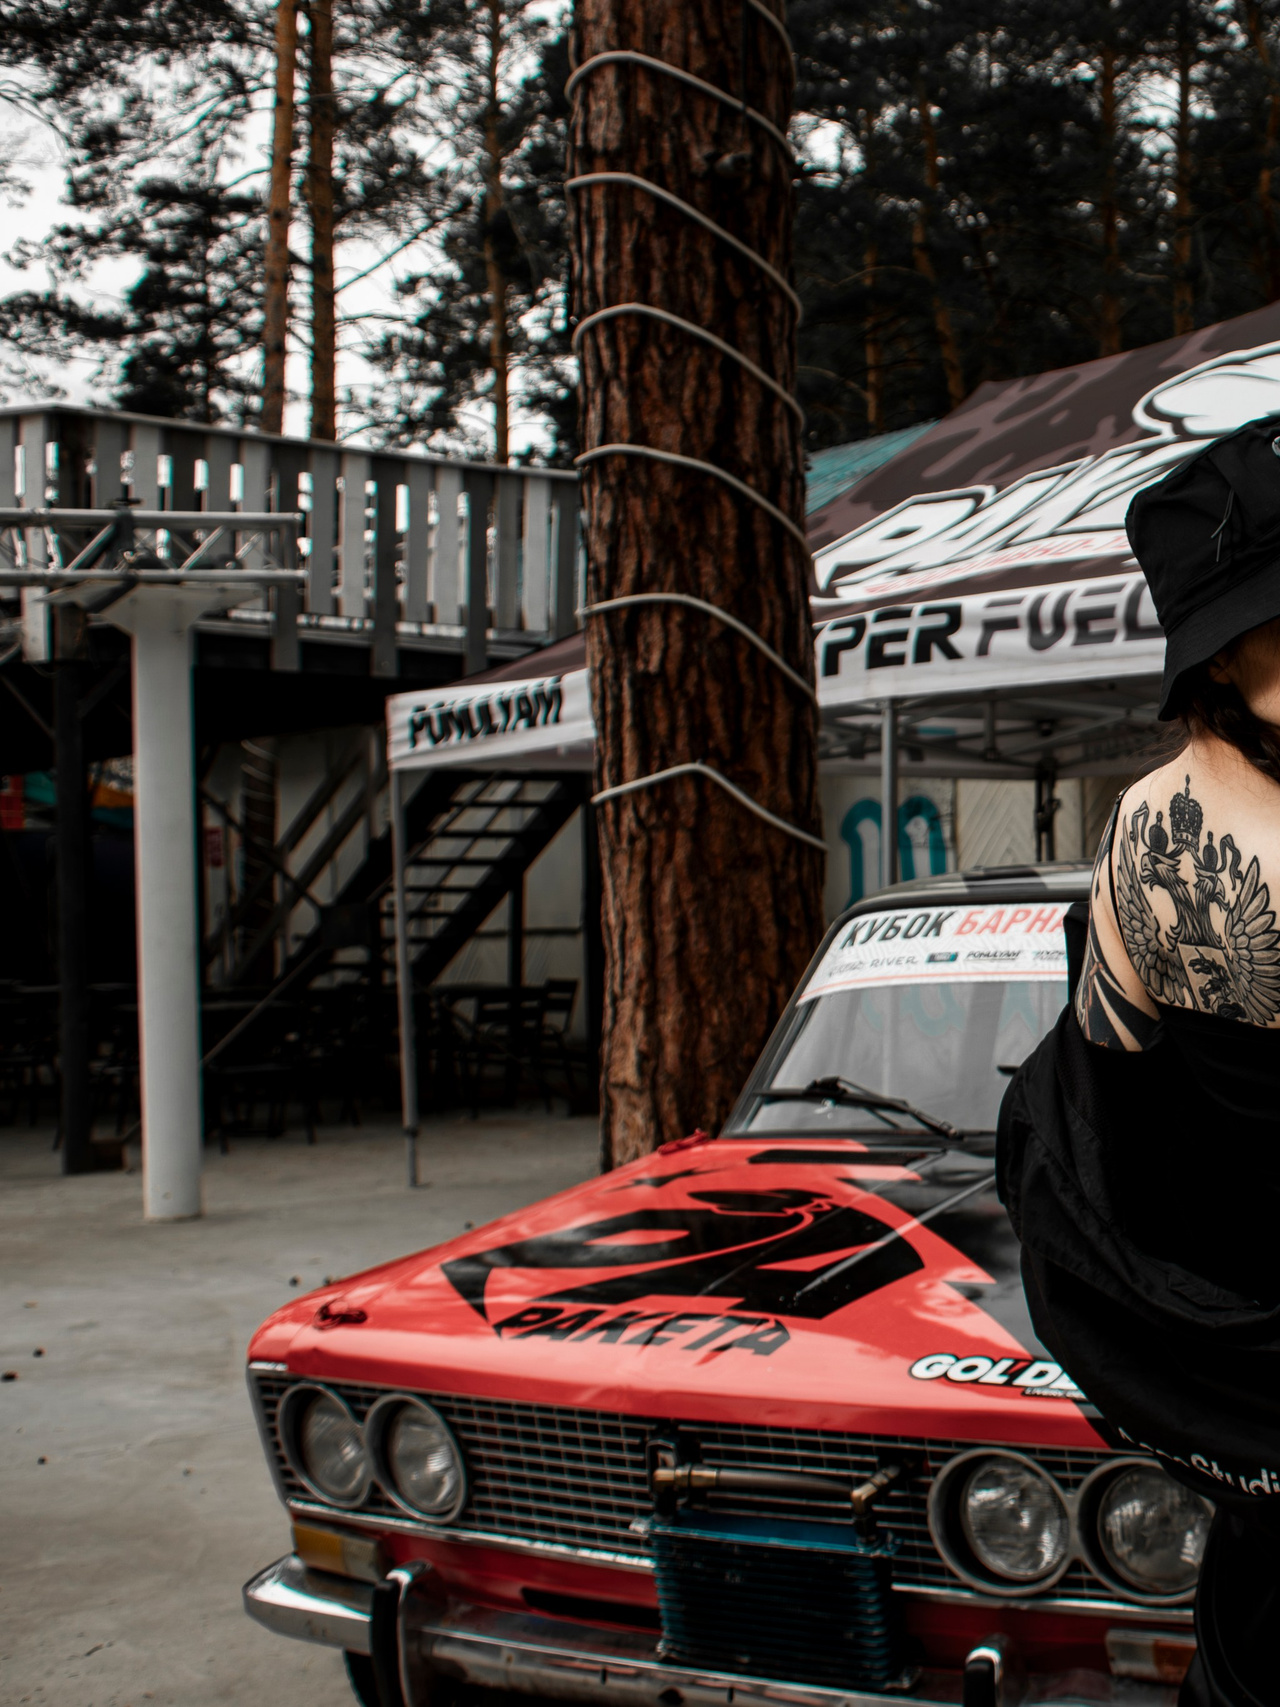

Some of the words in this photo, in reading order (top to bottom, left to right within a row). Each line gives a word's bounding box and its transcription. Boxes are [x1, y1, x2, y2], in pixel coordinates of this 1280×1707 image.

[814, 600, 964, 678] PER
[975, 578, 1166, 658] FUEL
[408, 675, 562, 749] PONULYAM
[840, 910, 958, 950] КУБОК
[869, 955, 919, 970] RIVER
